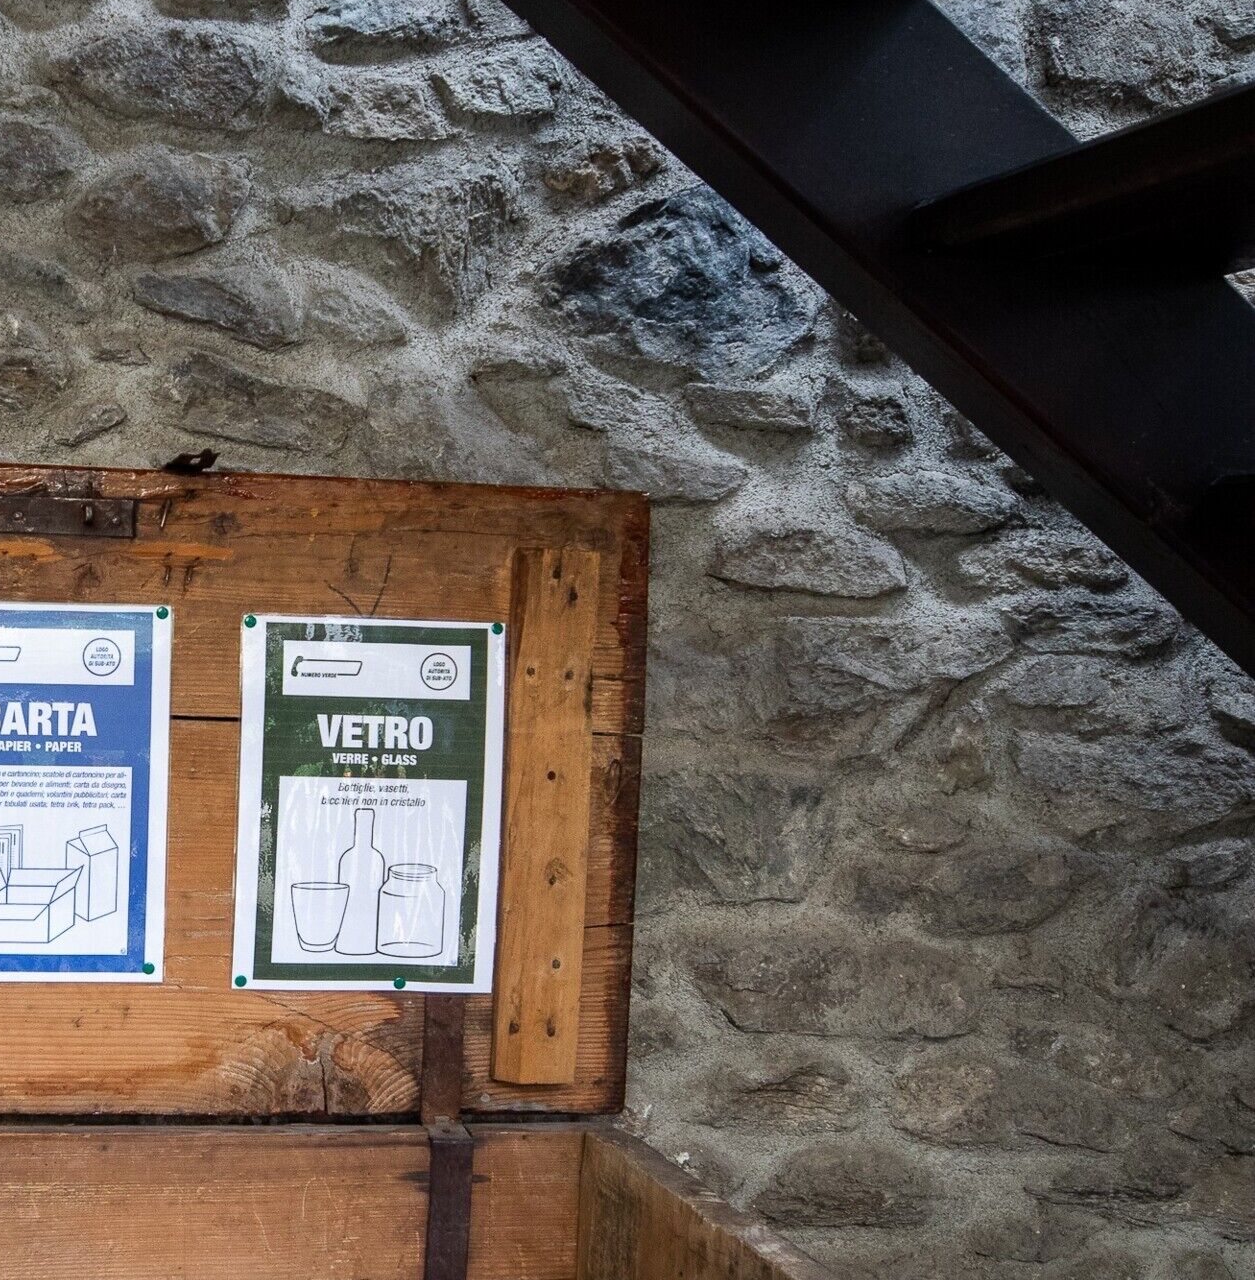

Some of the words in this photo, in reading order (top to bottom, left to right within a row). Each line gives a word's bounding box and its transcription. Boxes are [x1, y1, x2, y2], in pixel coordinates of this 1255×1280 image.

[317, 714, 434, 750] VETRO
[45, 741, 82, 752] PAPER
[332, 753, 369, 764] VERRE
[381, 754, 417, 766] GLASS
[390, 797, 426, 807] cristallo
